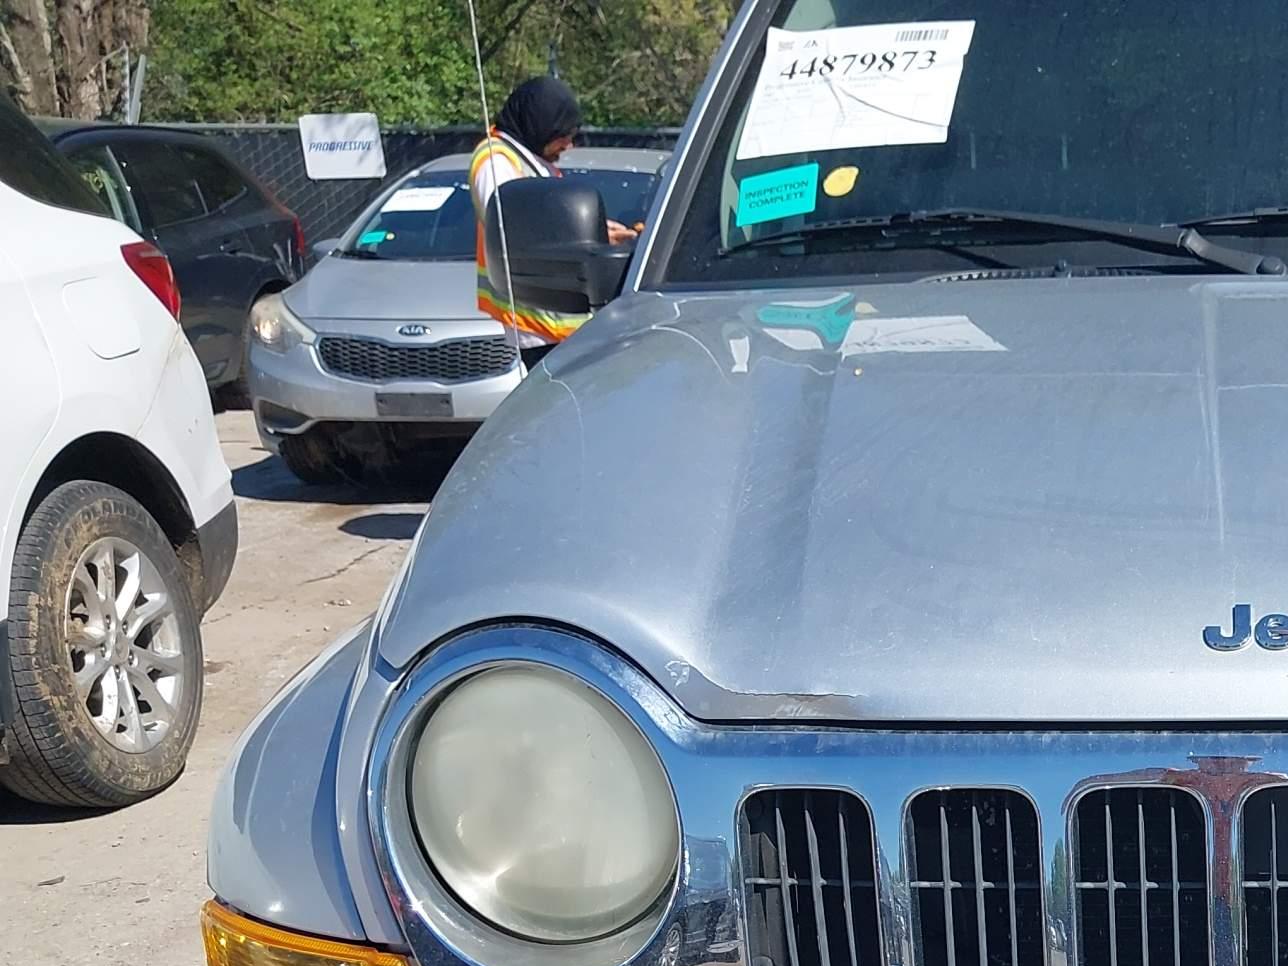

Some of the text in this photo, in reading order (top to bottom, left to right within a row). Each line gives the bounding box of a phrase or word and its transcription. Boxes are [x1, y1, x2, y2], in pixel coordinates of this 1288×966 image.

[780, 50, 937, 79] 44879873
[308, 141, 372, 152] PROGRESSIVE
[745, 180, 809, 199] INSPECTION
[749, 191, 804, 208] COMPLETE
